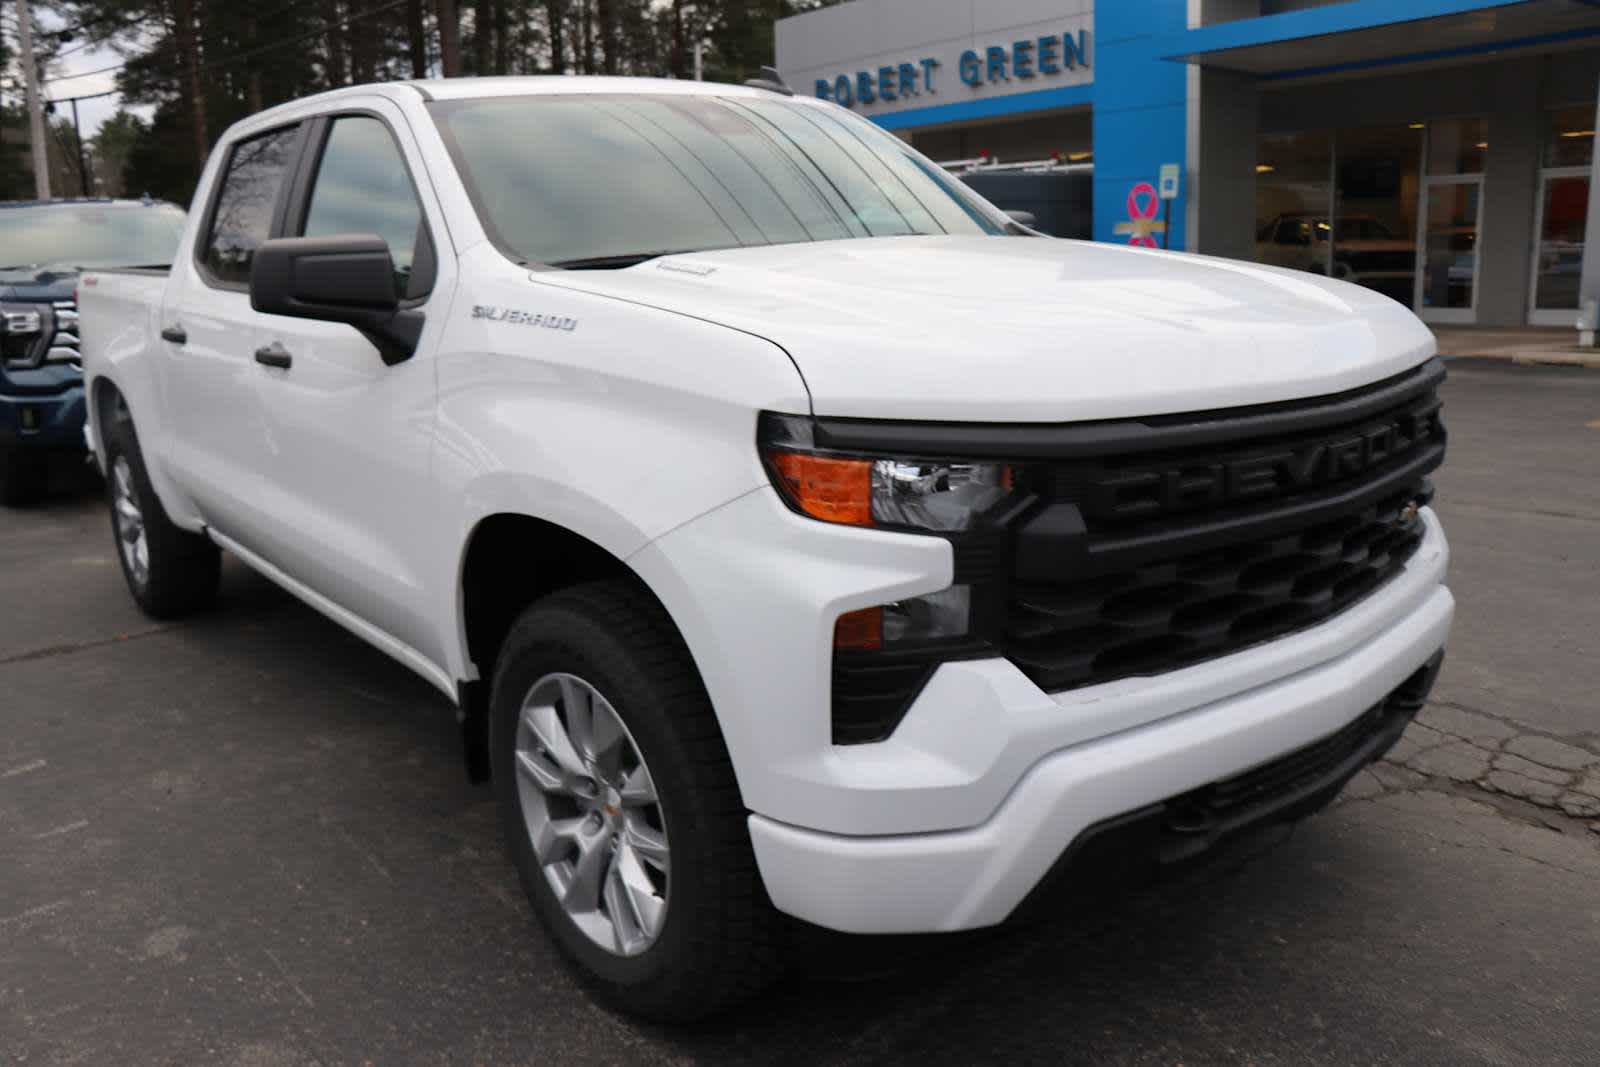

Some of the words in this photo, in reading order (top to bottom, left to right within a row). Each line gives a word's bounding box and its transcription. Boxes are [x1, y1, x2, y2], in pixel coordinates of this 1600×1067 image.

[815, 58, 940, 107] ROBERT
[959, 29, 1089, 87] GREEN
[472, 305, 578, 331] SILVERADO
[1097, 401, 1441, 513] CHEVROLE
